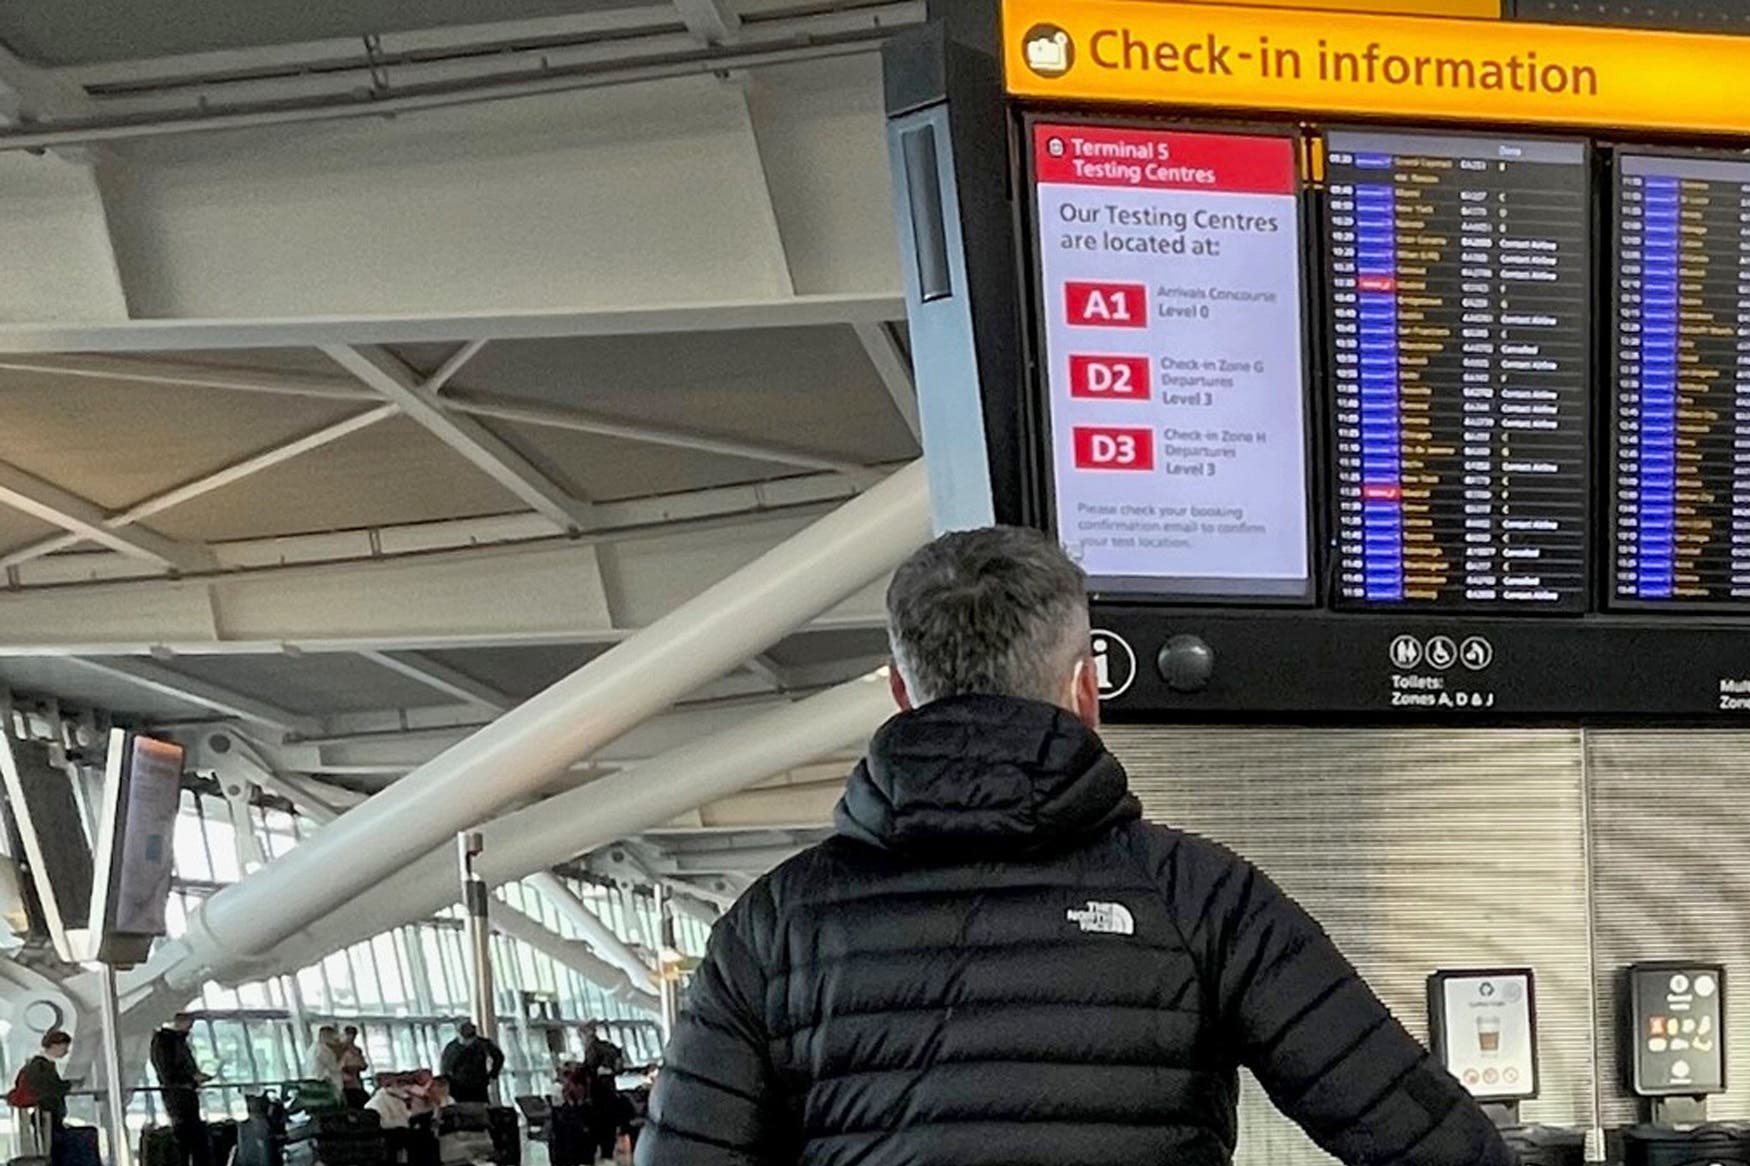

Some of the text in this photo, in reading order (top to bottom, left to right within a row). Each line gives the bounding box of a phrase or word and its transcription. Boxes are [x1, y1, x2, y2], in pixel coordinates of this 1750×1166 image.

[1089, 28, 1599, 96] Check-in information
[1070, 137, 1170, 160] Terminal 5
[1072, 158, 1217, 184] Testing Centres
[1059, 202, 1280, 232] Our Testing Centres
[1060, 230, 1221, 256] are located at:
[1082, 289, 1132, 321] A1
[1158, 304, 1197, 319] Level
[1160, 356, 1265, 374] Check-in Zone G
[1086, 362, 1133, 393] D2
[1161, 373, 1234, 390] Departures
[1162, 391, 1201, 406] Level
[1163, 428, 1268, 443] Check-in Zone H
[1091, 434, 1136, 464] D3
[1164, 443, 1237, 460] Departures
[1165, 461, 1205, 476] Level
[1391, 691, 1436, 706] Zones
[1455, 692, 1468, 707] D
[1485, 692, 1495, 707] J
